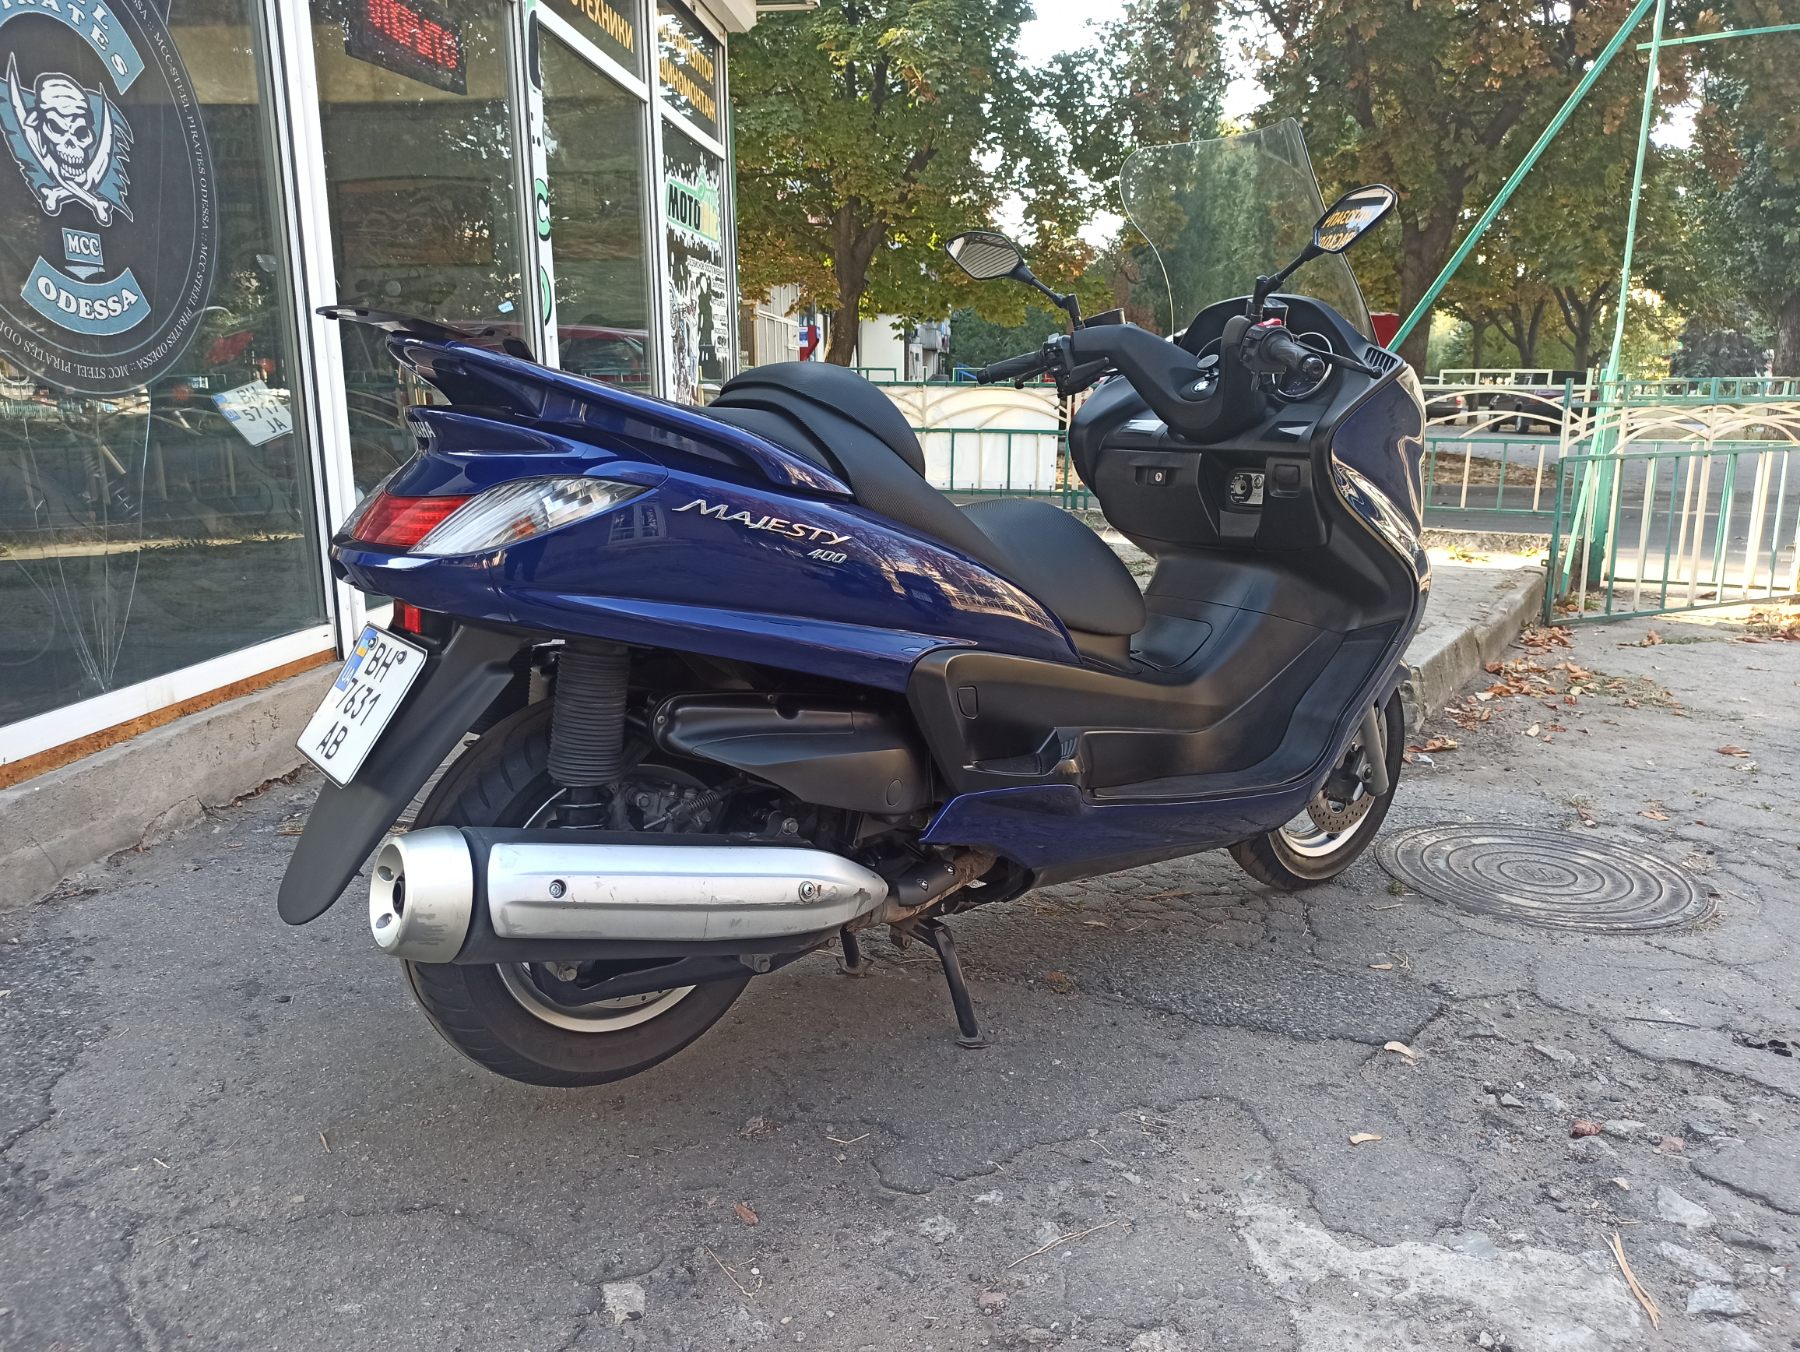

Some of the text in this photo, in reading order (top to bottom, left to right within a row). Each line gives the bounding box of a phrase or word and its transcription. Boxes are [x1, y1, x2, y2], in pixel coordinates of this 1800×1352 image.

[186, 115, 207, 175] PIRATES
[200, 176, 209, 229] ODESSA
[66, 233, 100, 256] MCC
[37, 276, 139, 320] ODESSA
[24, 340, 72, 374] PIRATES
[108, 364, 129, 378] MCC
[136, 342, 169, 371] ODESSA
[672, 499, 852, 545] MAJESTY
[807, 549, 848, 564] 400
[341, 665, 356, 685] UA
[364, 642, 399, 683] BH
[336, 677, 382, 726] 7631
[316, 720, 348, 760] AB
